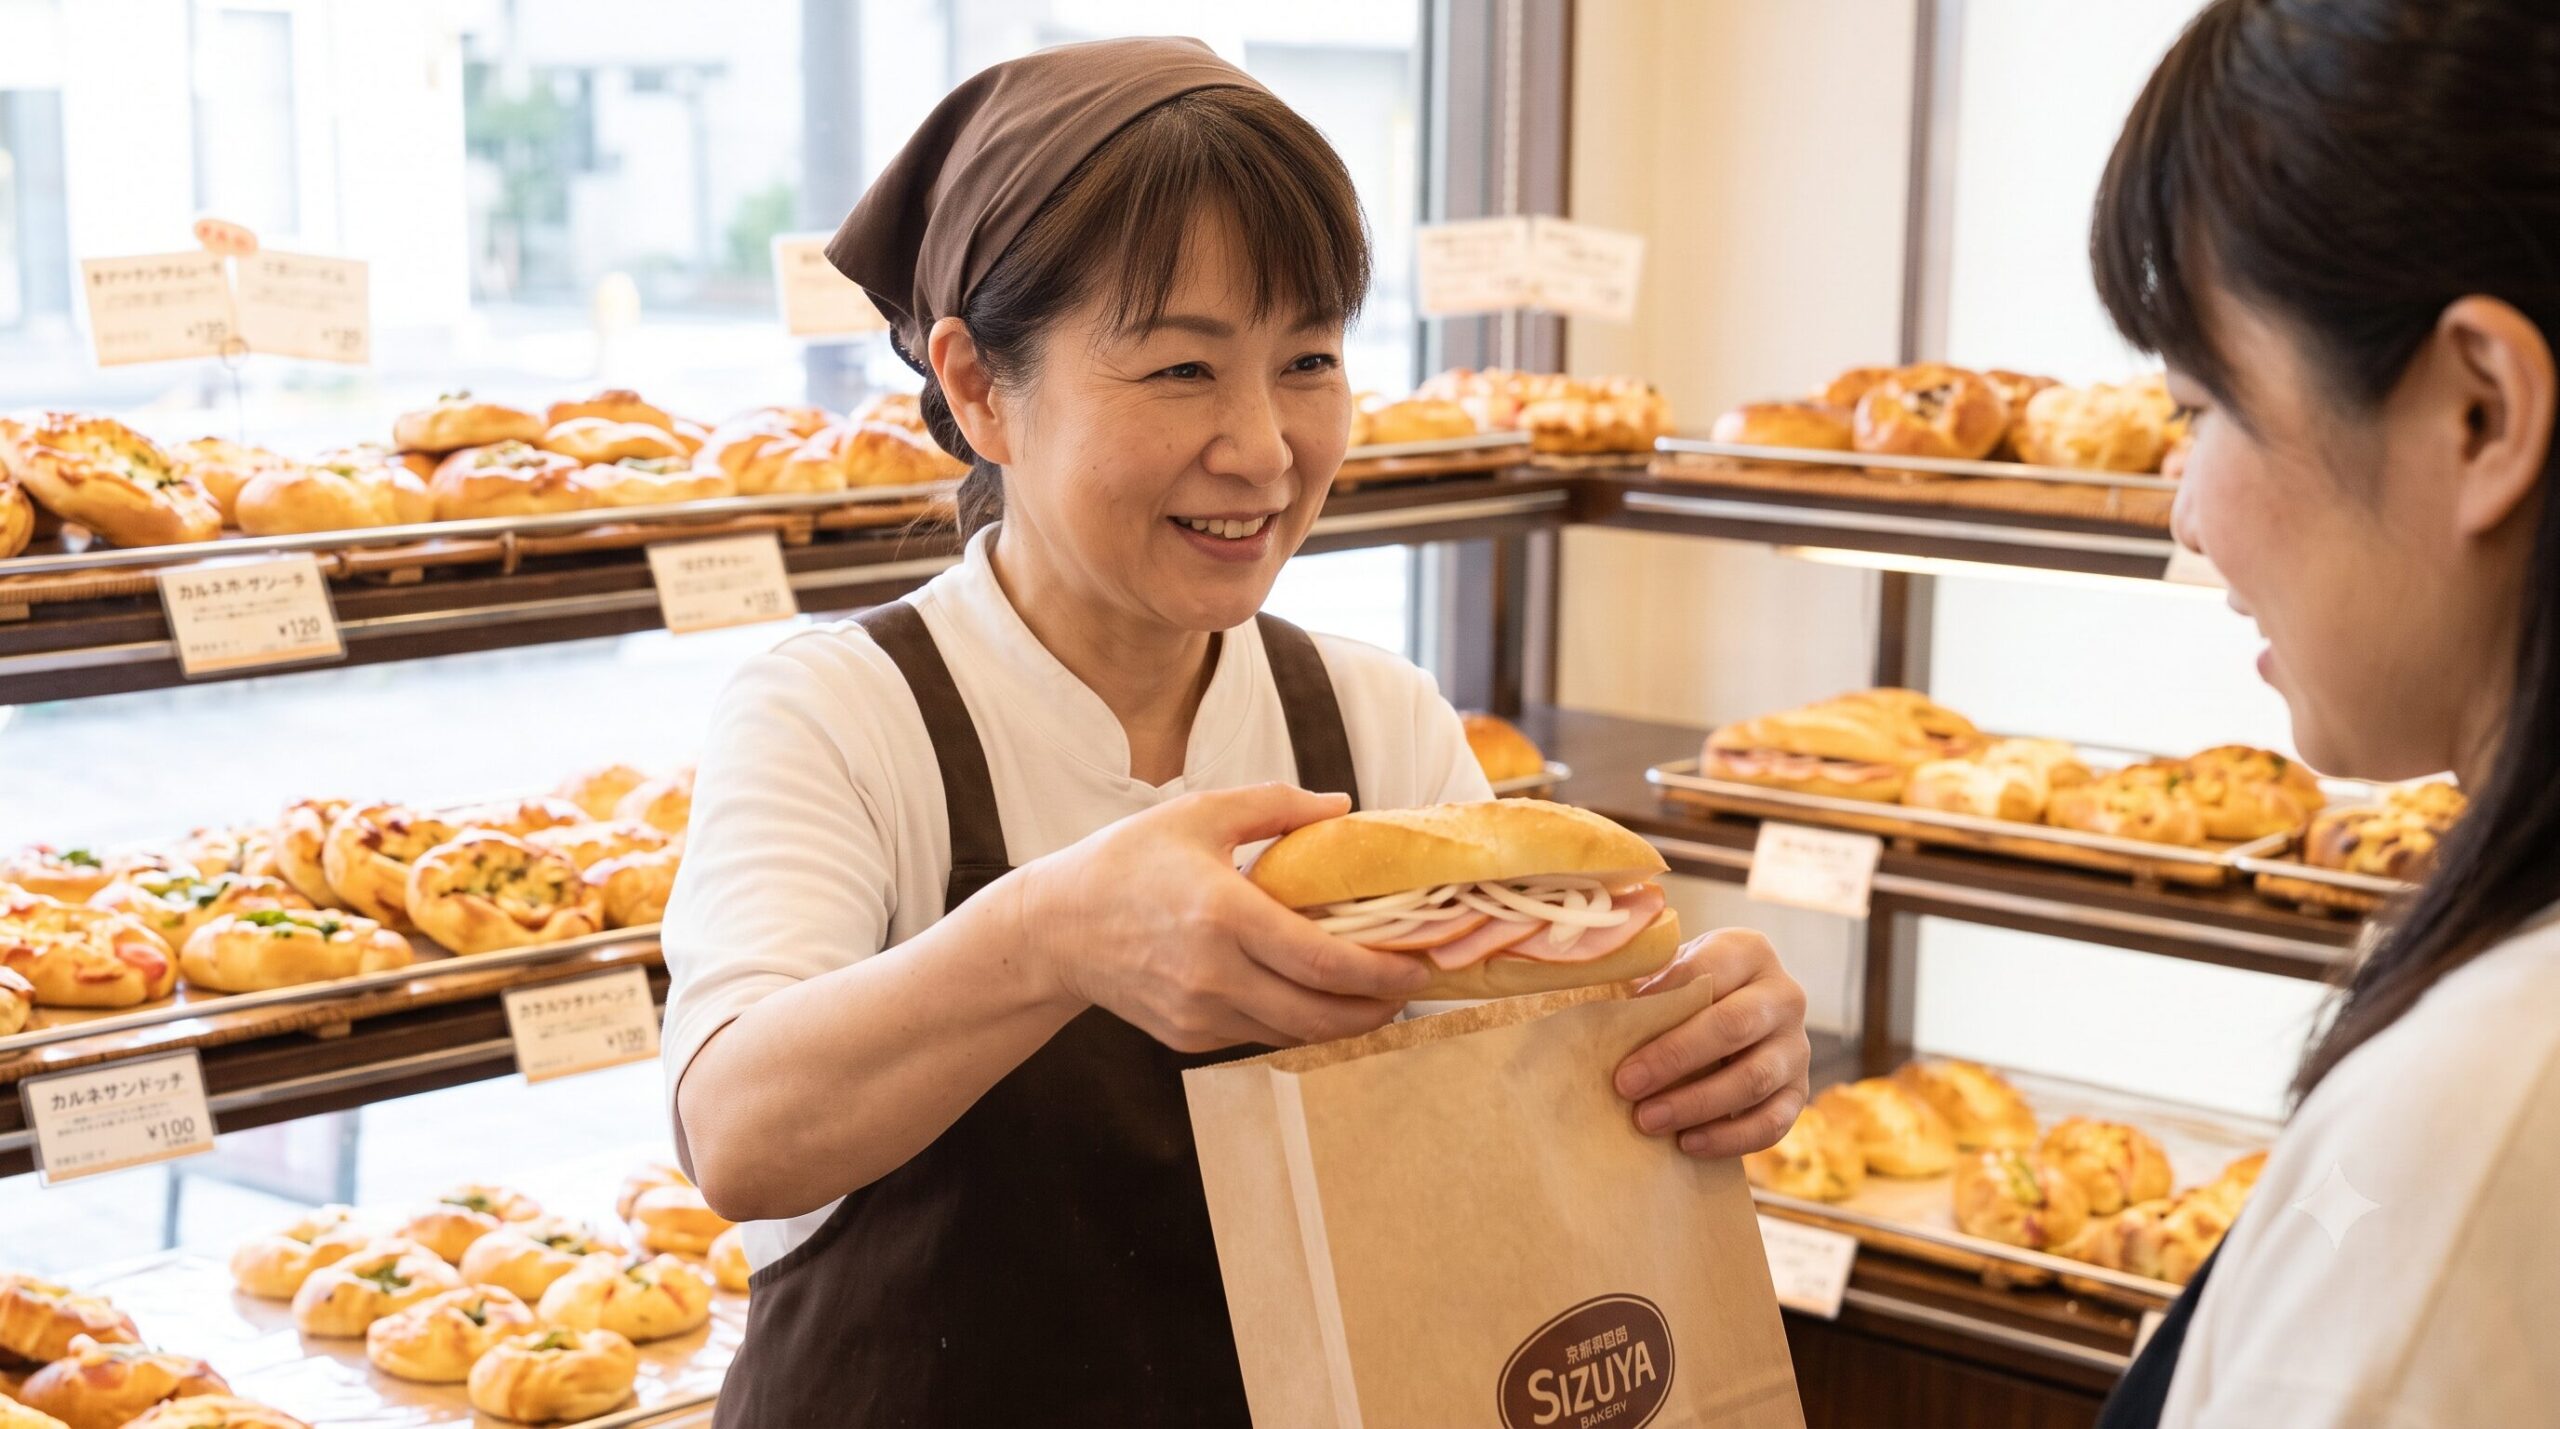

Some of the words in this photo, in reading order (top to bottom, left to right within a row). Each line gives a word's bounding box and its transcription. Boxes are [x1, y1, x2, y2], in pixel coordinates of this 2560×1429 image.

[51, 1072, 184, 1111] カルネサンドッチ
[146, 1116, 196, 1140] ¥100
[1527, 1340, 1657, 1426] SIZUYA
[1580, 1400, 1628, 1429] BAKERY
